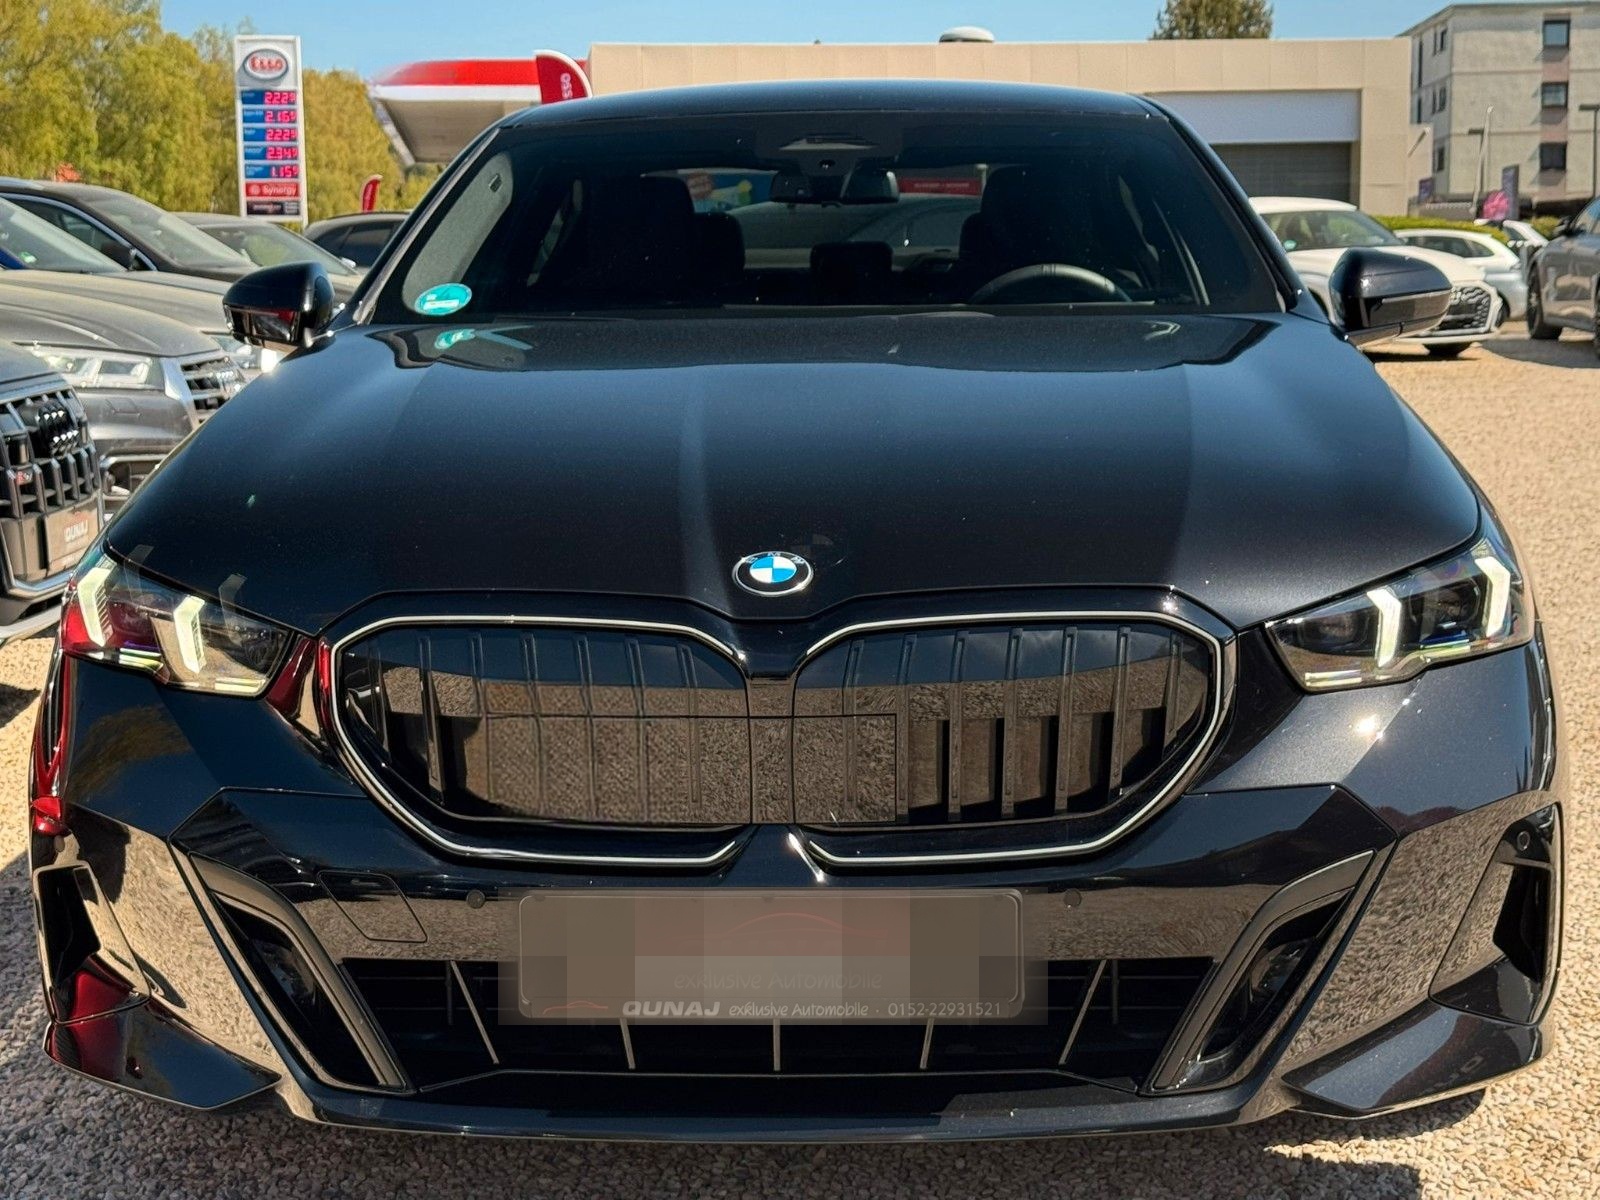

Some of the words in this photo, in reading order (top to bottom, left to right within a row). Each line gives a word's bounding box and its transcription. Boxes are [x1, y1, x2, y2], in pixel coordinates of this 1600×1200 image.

[261, 183, 297, 196] Synergy
[621, 1001, 721, 1017] QUNAJ
[728, 1002, 789, 1017] exklusive
[791, 1002, 869, 1017] Automobile
